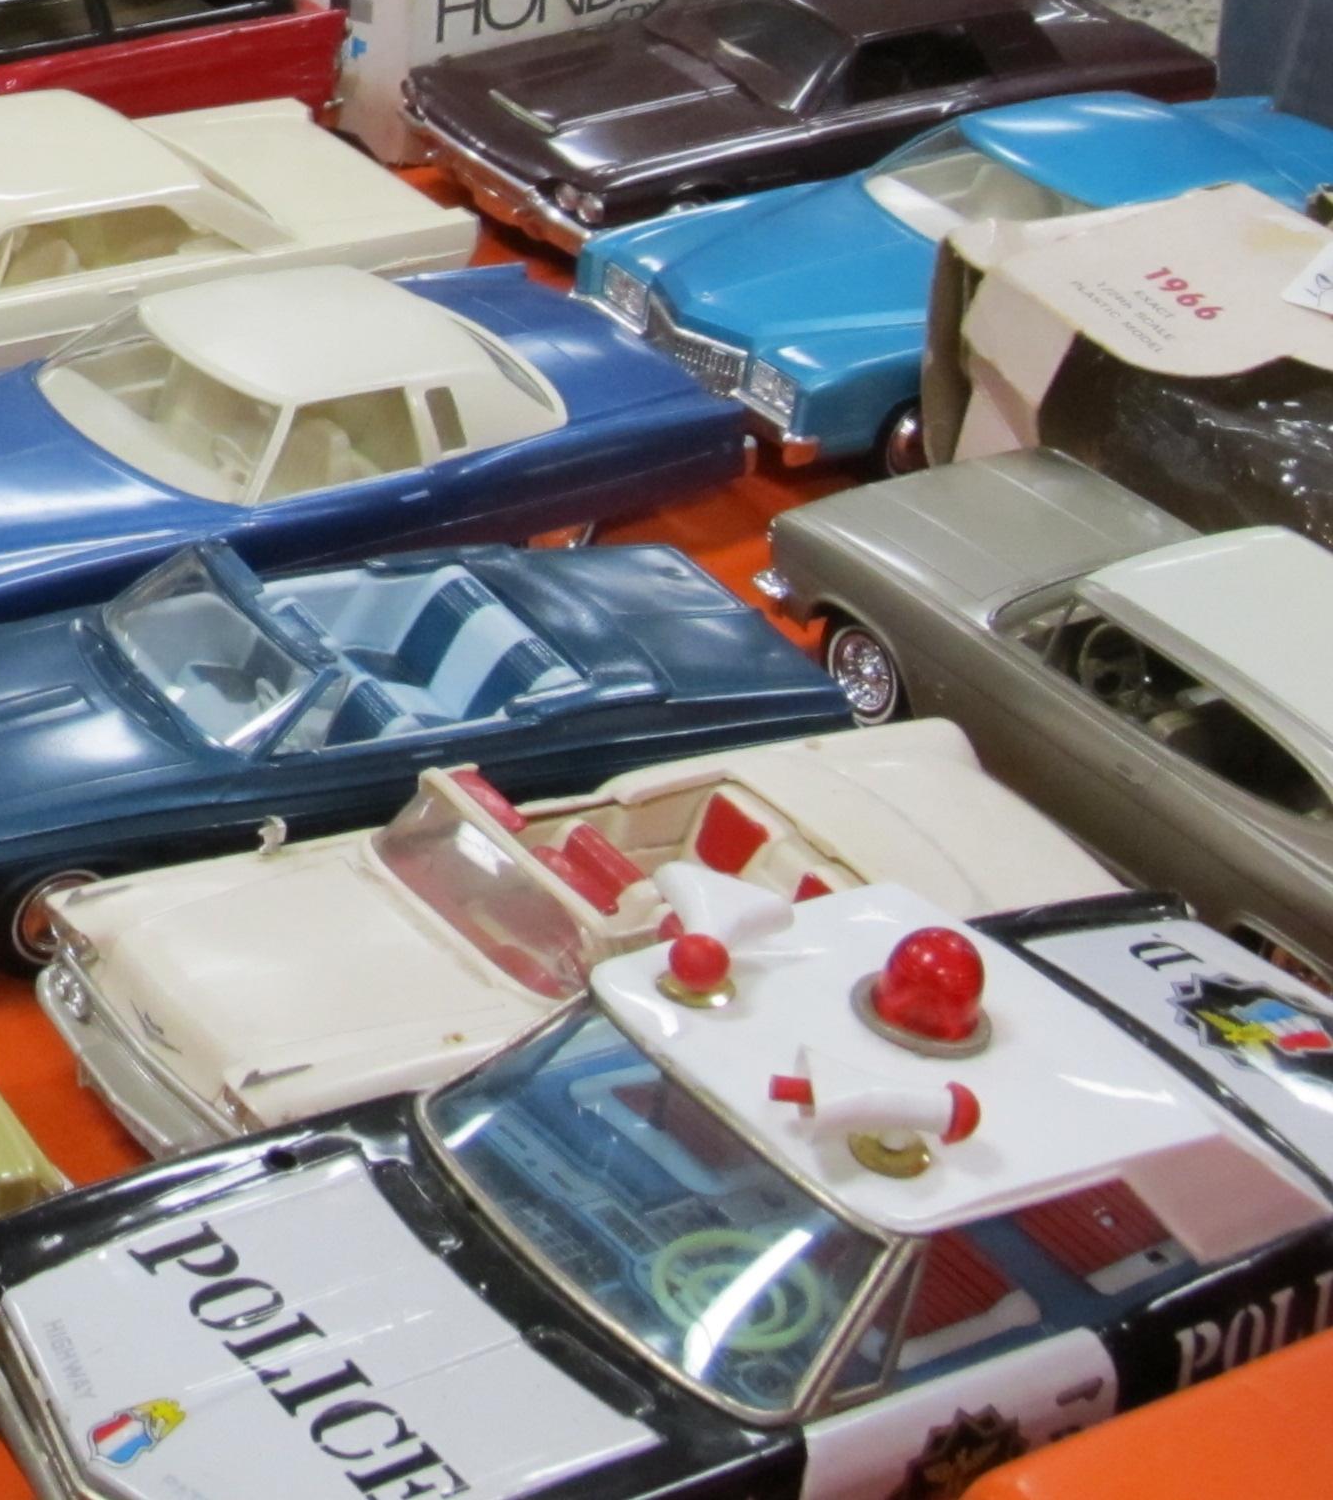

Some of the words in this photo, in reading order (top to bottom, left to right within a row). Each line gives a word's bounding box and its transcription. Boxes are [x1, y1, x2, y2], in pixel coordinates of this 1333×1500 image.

[1134, 289, 1176, 319] EXACT
[1142, 266, 1226, 321] 1966
[1122, 320, 1164, 354] MODEL
[1136, 311, 1176, 342] SCALE
[41, 1317, 99, 1400] HIGHWAY
[126, 1220, 472, 1500] POLICE
